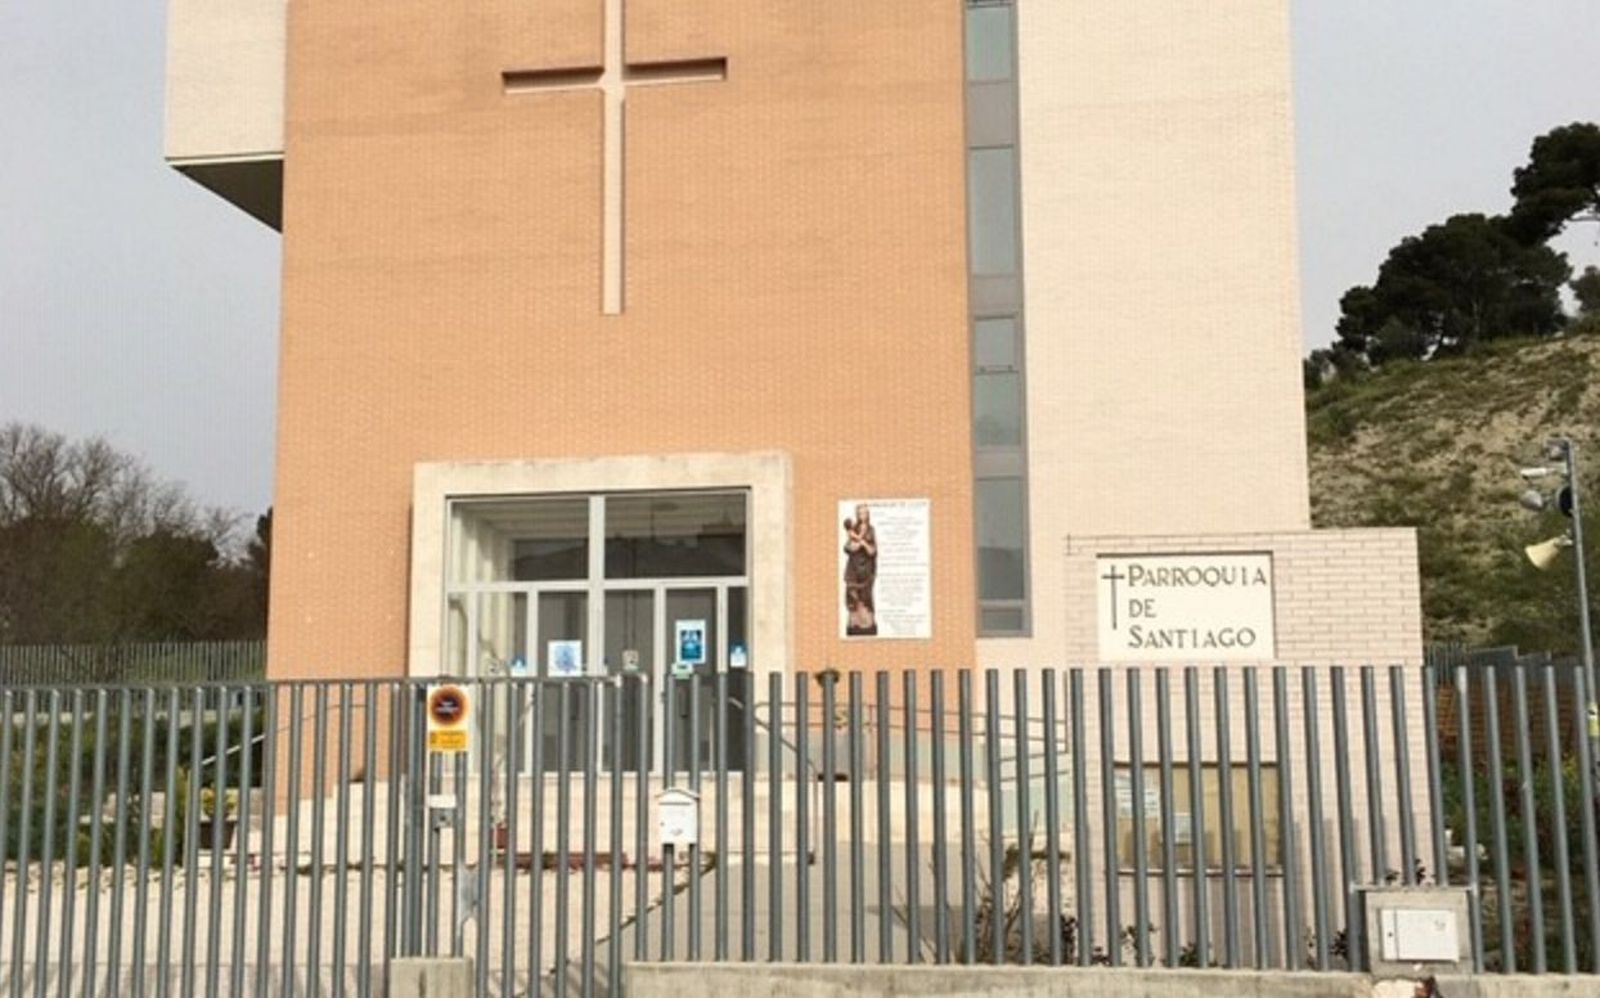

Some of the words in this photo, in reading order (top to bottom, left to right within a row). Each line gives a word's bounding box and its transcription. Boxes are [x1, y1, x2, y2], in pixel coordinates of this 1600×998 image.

[1128, 564, 1267, 587] PARROQUIA
[1129, 599, 1156, 618] DE
[1128, 625, 1256, 648] SANTIAGO
